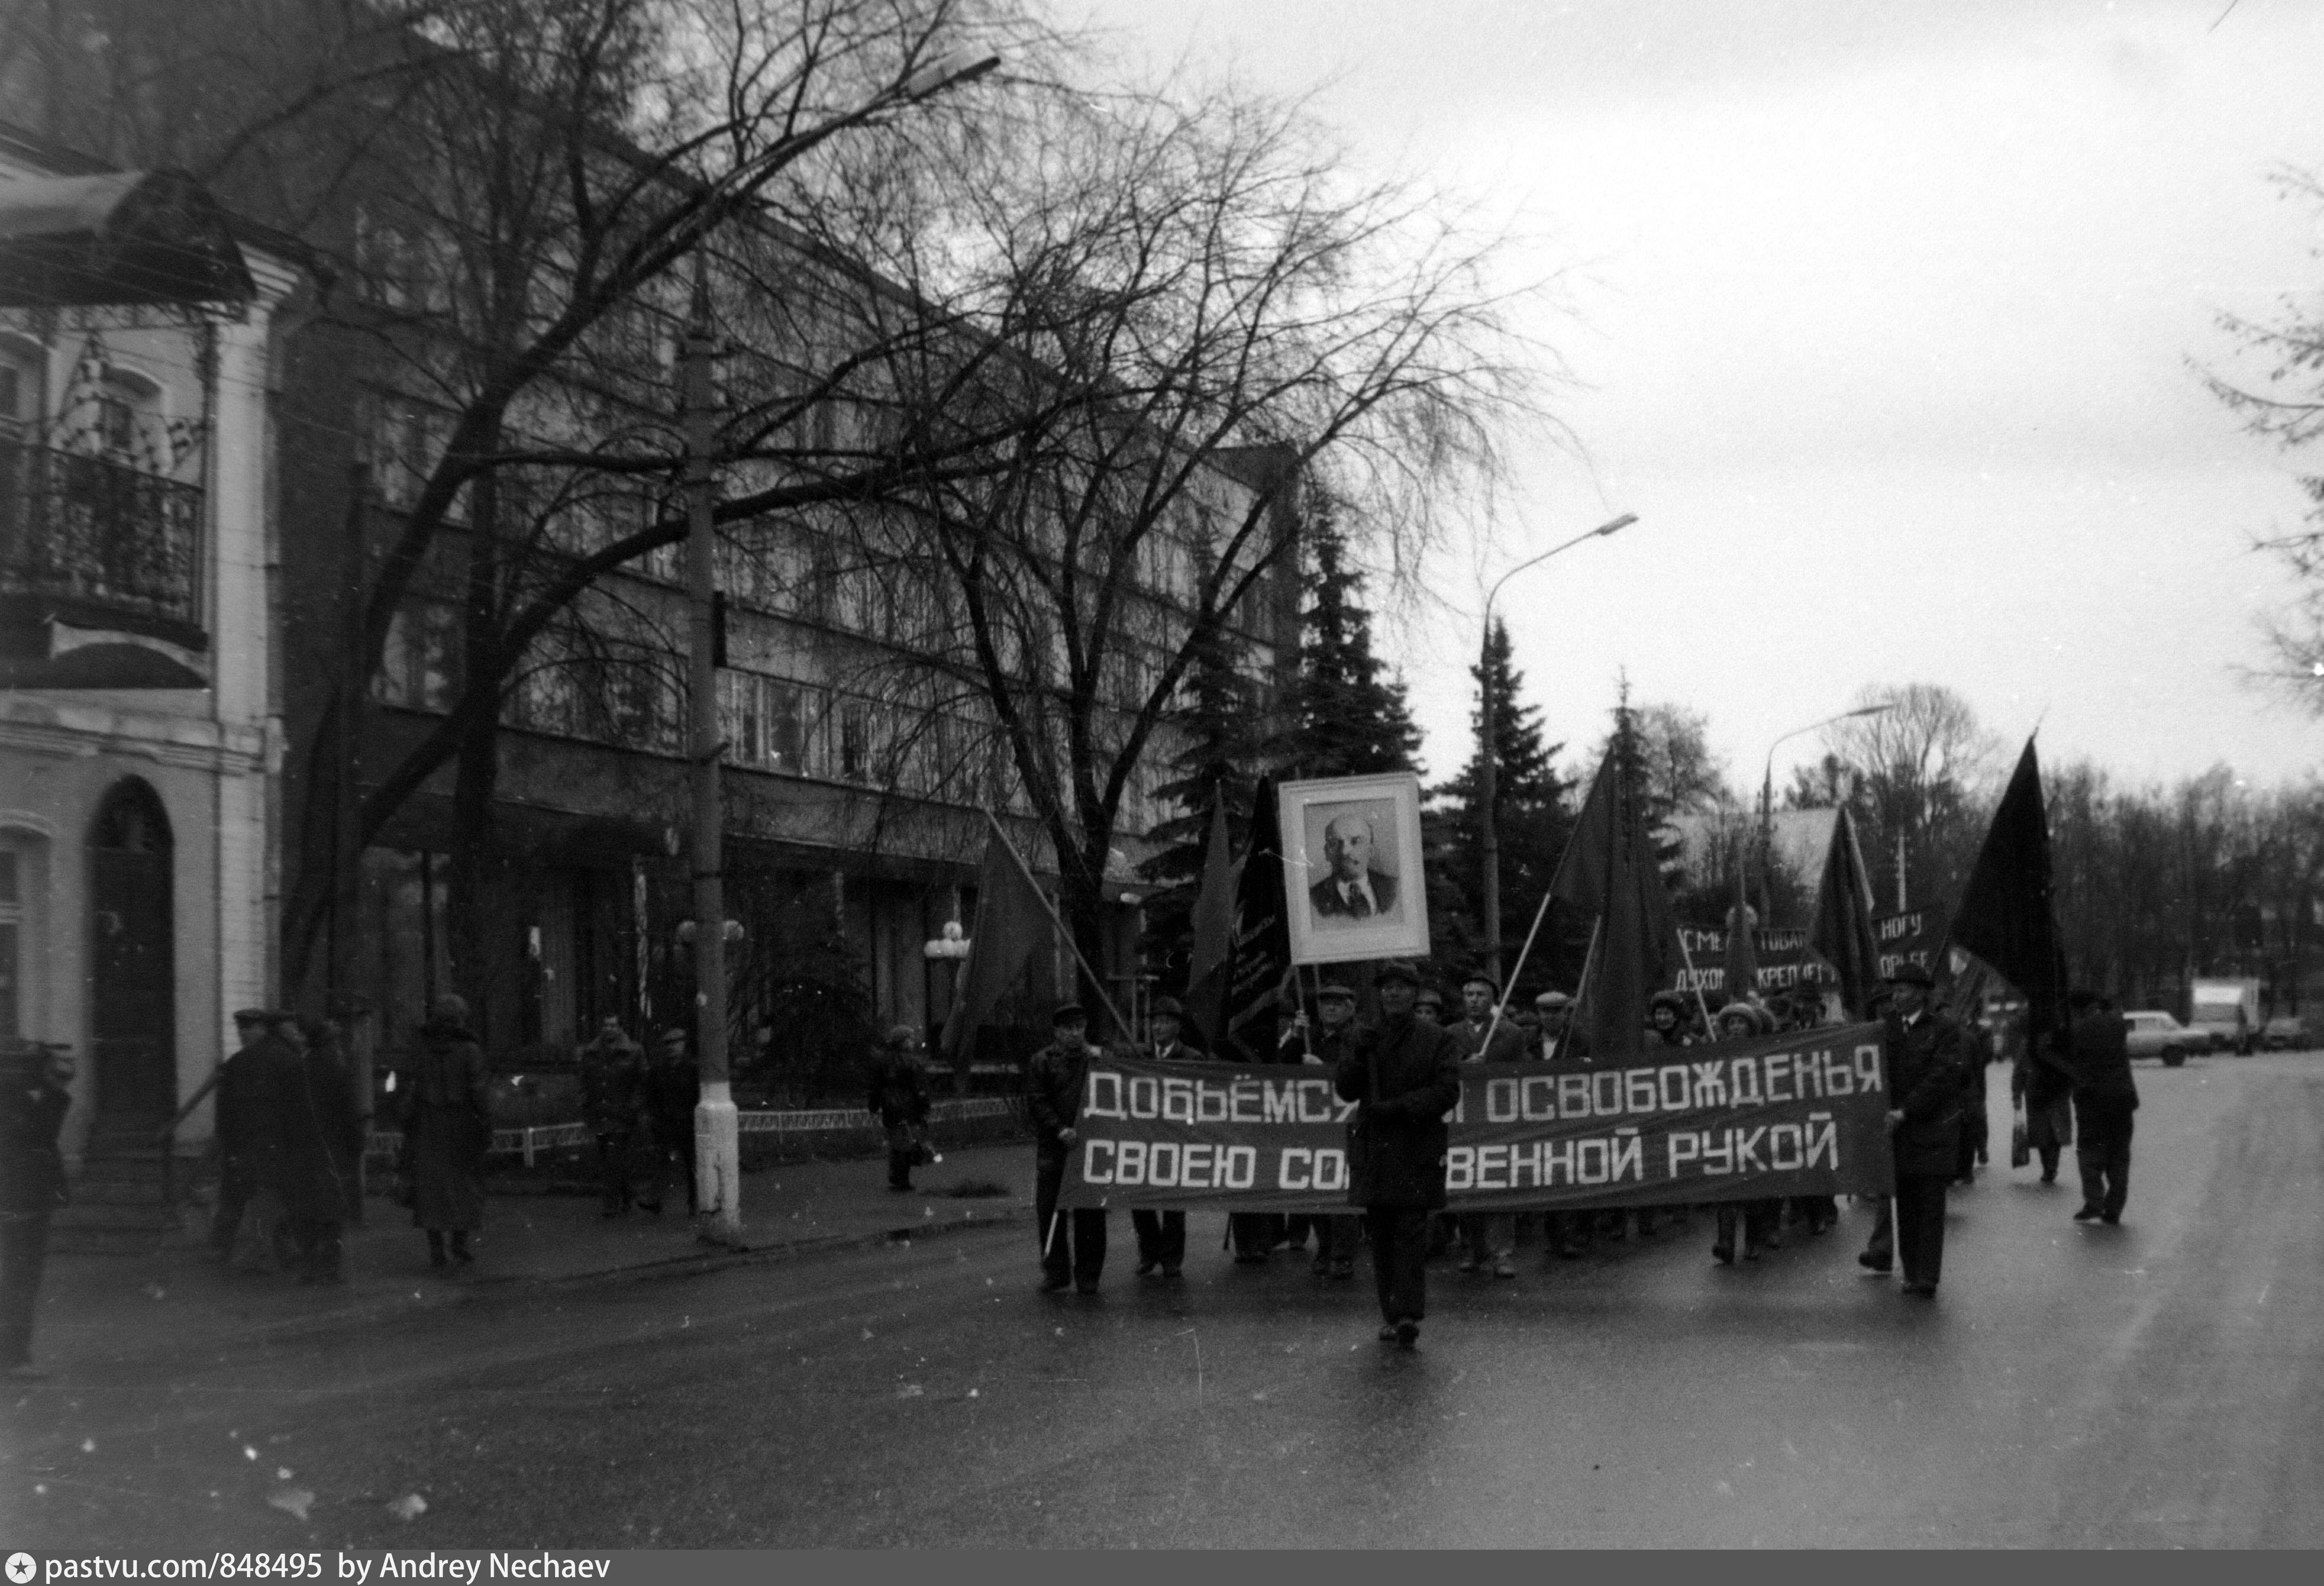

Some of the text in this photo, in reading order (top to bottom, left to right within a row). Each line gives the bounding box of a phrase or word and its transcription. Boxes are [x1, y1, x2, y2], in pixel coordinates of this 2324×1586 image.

[1760, 931, 1804, 951] ТОВА
[1881, 914, 1921, 941] НОГУ
[1487, 1045, 1882, 1122] ОСВОБОЖДЕНЬЯ
[1084, 1139, 1256, 1189] СВОЕЮ
[1669, 1112, 1839, 1178] РУКОЙ
